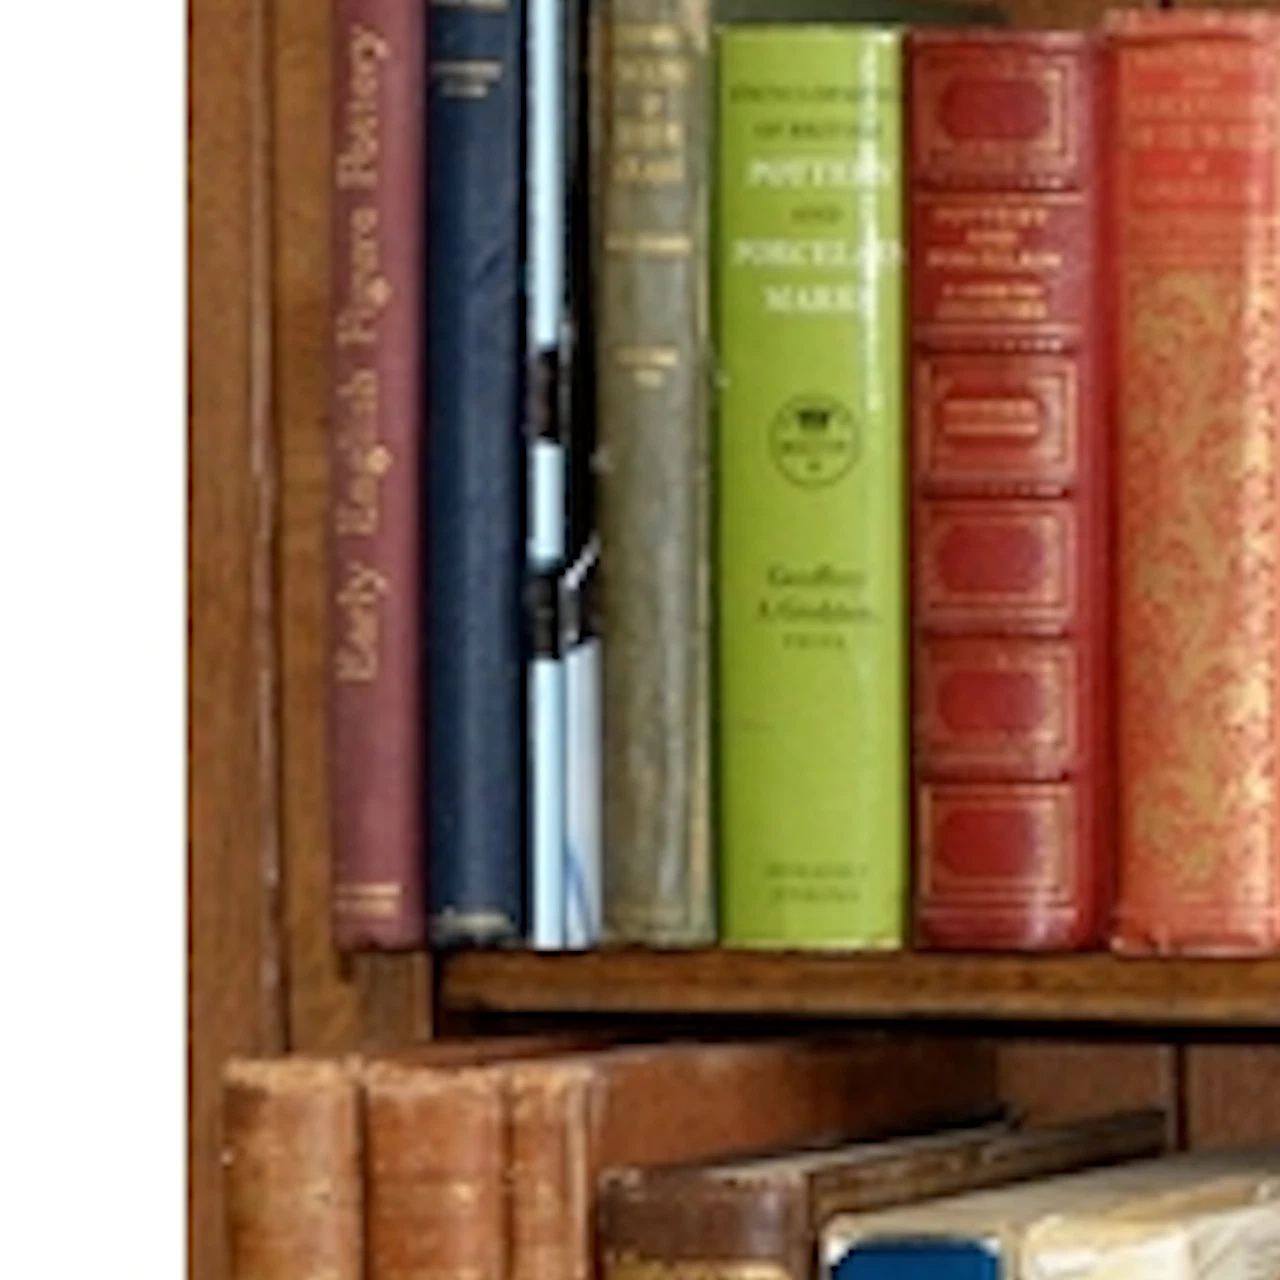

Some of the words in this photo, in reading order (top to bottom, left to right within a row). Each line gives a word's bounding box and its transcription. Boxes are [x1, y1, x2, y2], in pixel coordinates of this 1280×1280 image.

[335, 25, 390, 191] Pottery
[748, 159, 891, 186] POTTERY
[336, 208, 391, 350] Figure
[336, 371, 391, 538] English
[335, 565, 388, 683] Early
